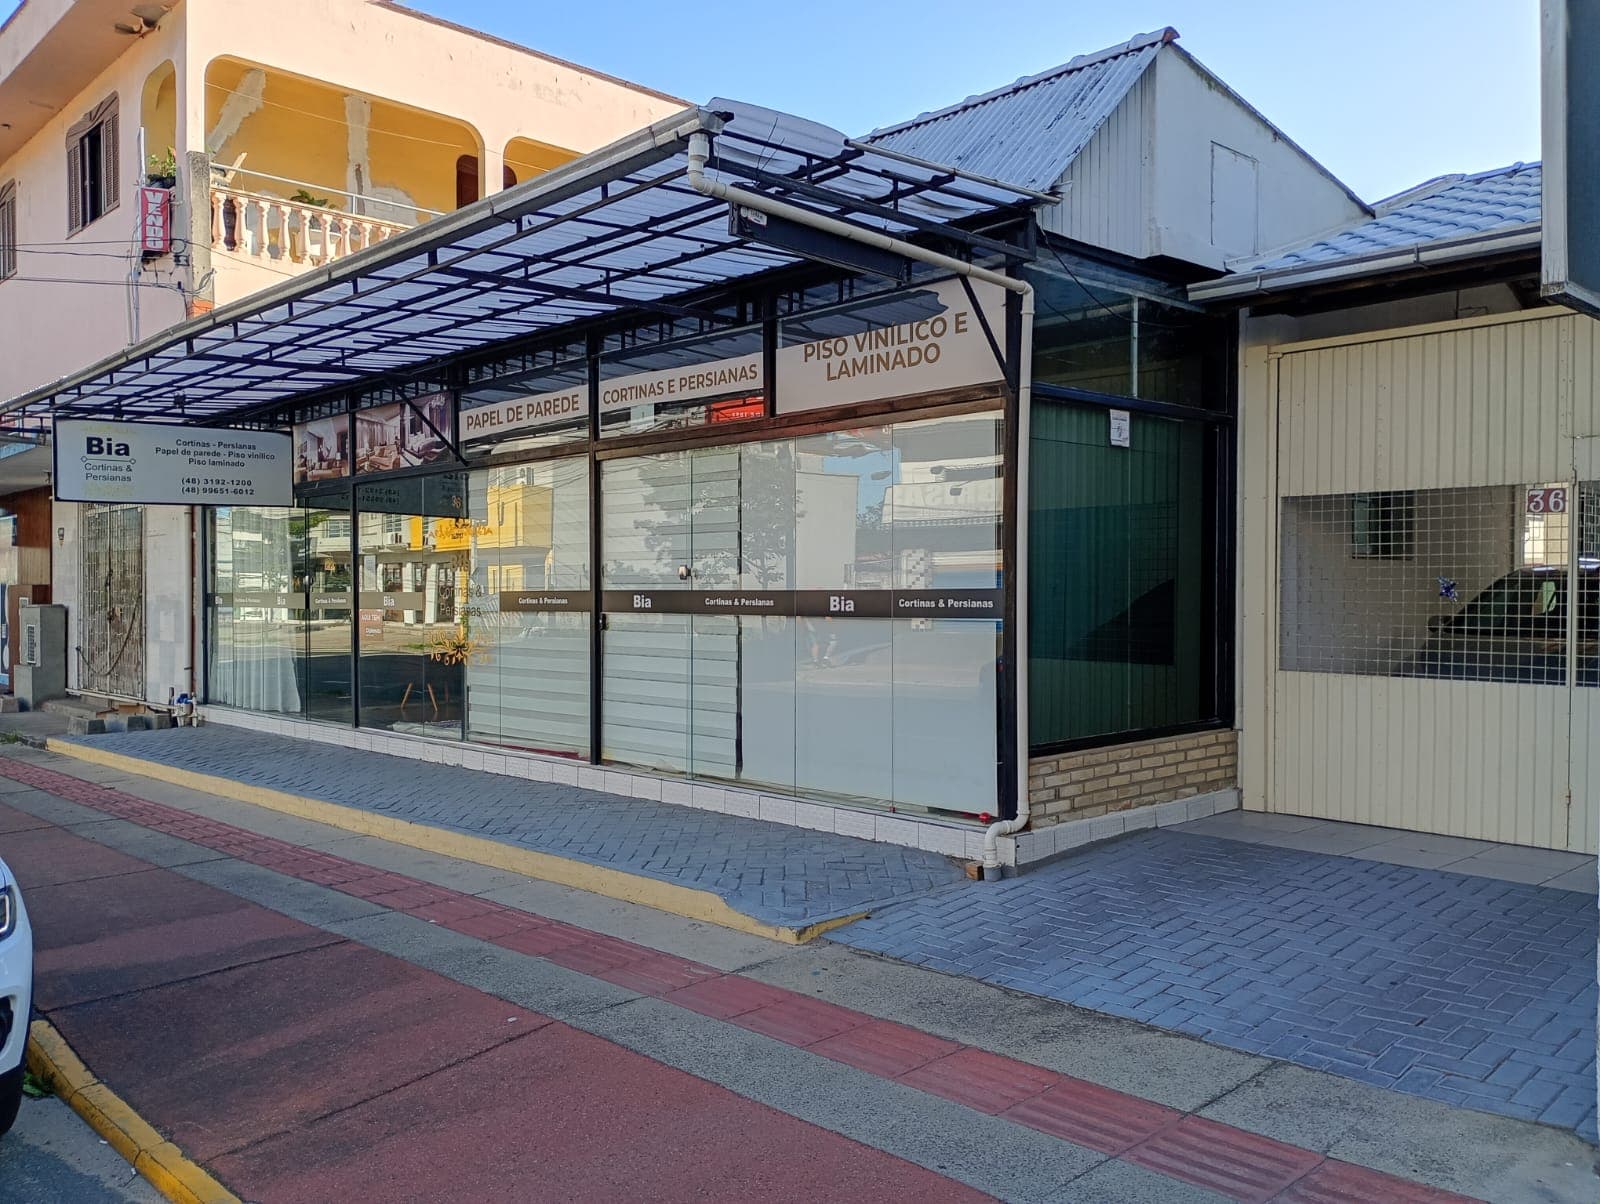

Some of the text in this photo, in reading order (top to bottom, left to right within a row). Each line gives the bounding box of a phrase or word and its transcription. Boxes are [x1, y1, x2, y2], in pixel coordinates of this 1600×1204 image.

[144, 190, 164, 249] VENDO
[803, 337, 849, 362] PISO
[954, 311, 968, 334] E
[826, 342, 941, 381] LAMINADO
[602, 363, 758, 405] CORTINAS E PERSIANAS
[466, 393, 580, 431] PAPEL DE PAREDE
[86, 436, 130, 456] Bia
[176, 439, 210, 448] Cortinas
[217, 441, 256, 450] Persianas
[155, 446, 179, 456] Papel
[181, 448, 192, 456] de
[193, 449, 221, 458] parede
[228, 451, 246, 459] Piso
[84, 462, 132, 472] Cortinas &
[188, 458, 245, 467] Piso laminado
[85, 472, 132, 482] Persianas
[181, 477, 252, 486] (48) 3192-1200
[181, 486, 200, 495] (48)
[1528, 489, 1564, 512] 36
[632, 594, 652, 609] Bia
[704, 597, 733, 606] Cortinas
[740, 597, 774, 607] Persianas
[829, 595, 855, 612] Bia
[897, 598, 994, 610] Cortinas & Persianas
